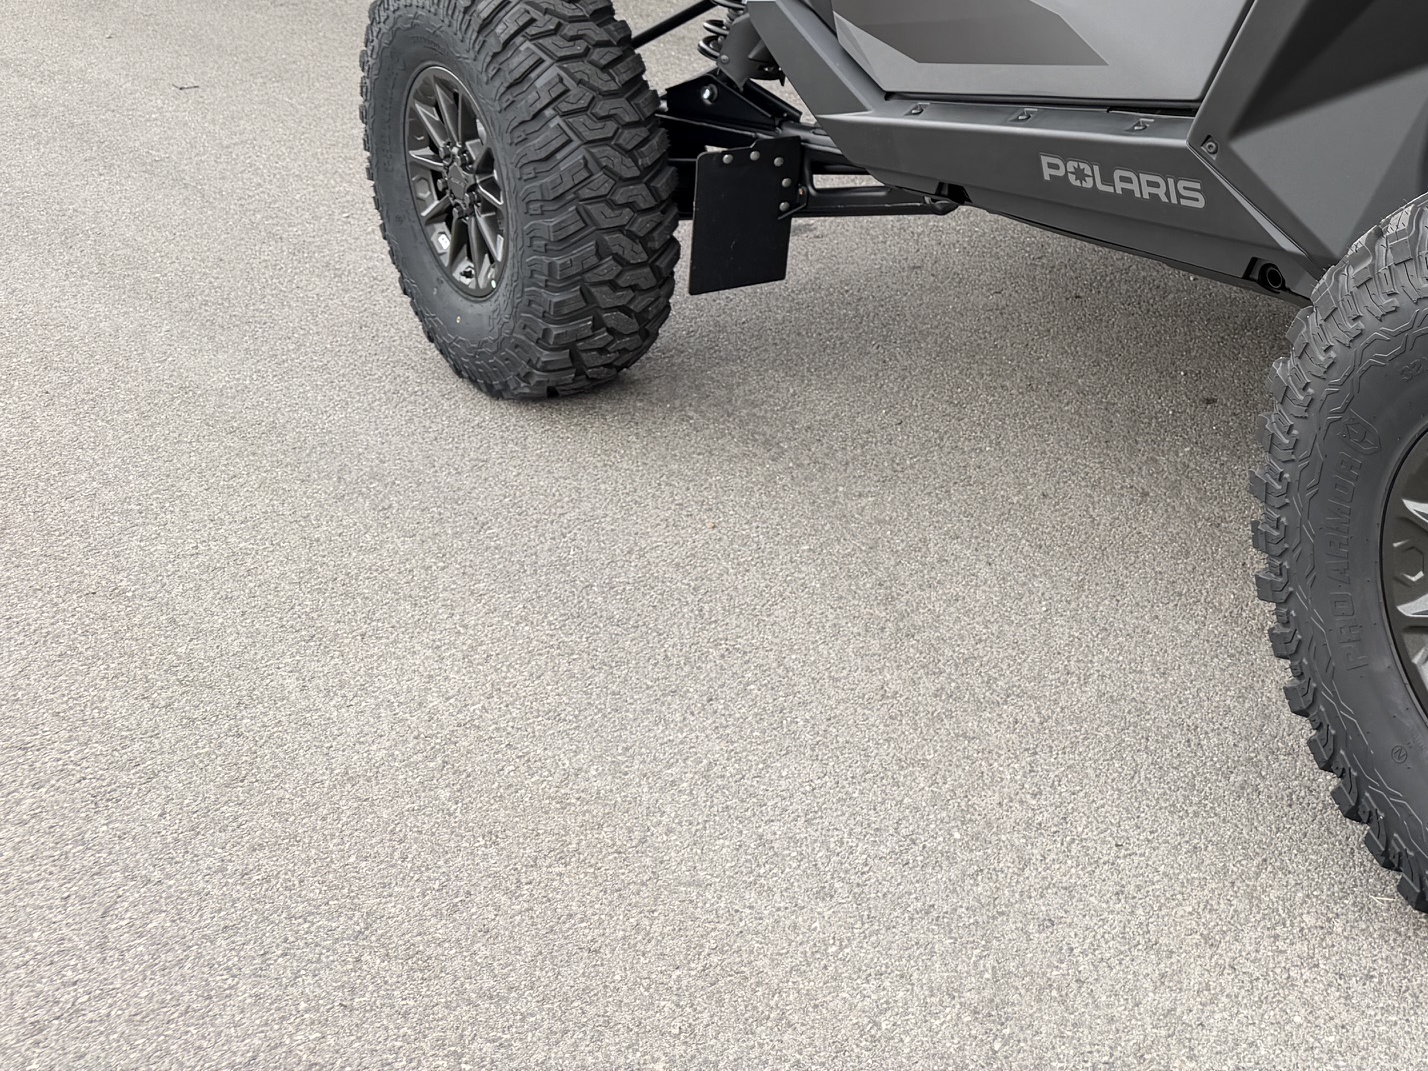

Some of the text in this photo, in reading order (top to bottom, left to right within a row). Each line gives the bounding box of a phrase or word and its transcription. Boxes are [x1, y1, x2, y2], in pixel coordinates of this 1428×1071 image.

[1040, 154, 1206, 209] POLARIS
[1325, 450, 1369, 672] PRO ARMOR
